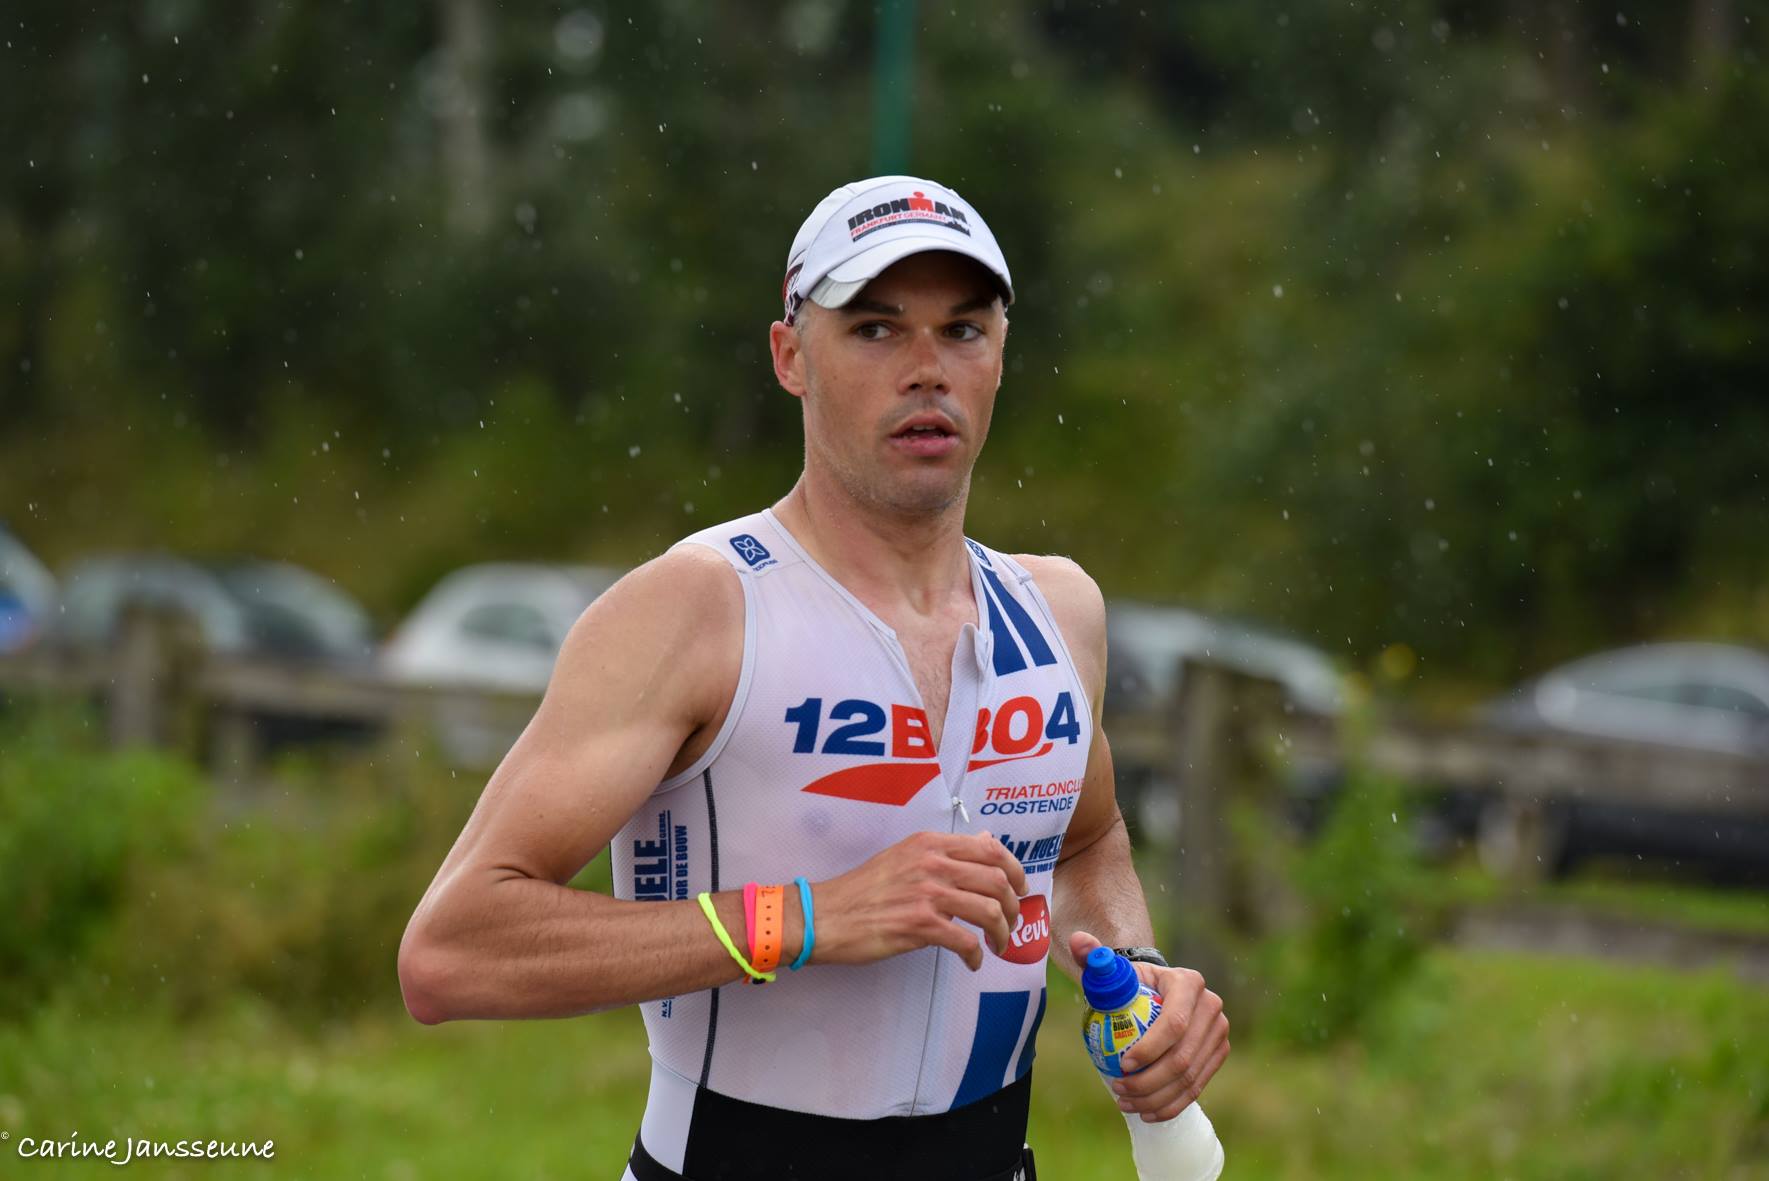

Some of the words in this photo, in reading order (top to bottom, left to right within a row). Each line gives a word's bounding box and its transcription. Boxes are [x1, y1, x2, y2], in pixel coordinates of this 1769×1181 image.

[848, 191, 968, 230] IRONMAN
[851, 212, 902, 236] FRANKFURT
[981, 796, 1074, 816] OOSTENDE
[674, 825, 688, 862] BOUW
[634, 839, 668, 901] ELE
[675, 862, 689, 877] DE
